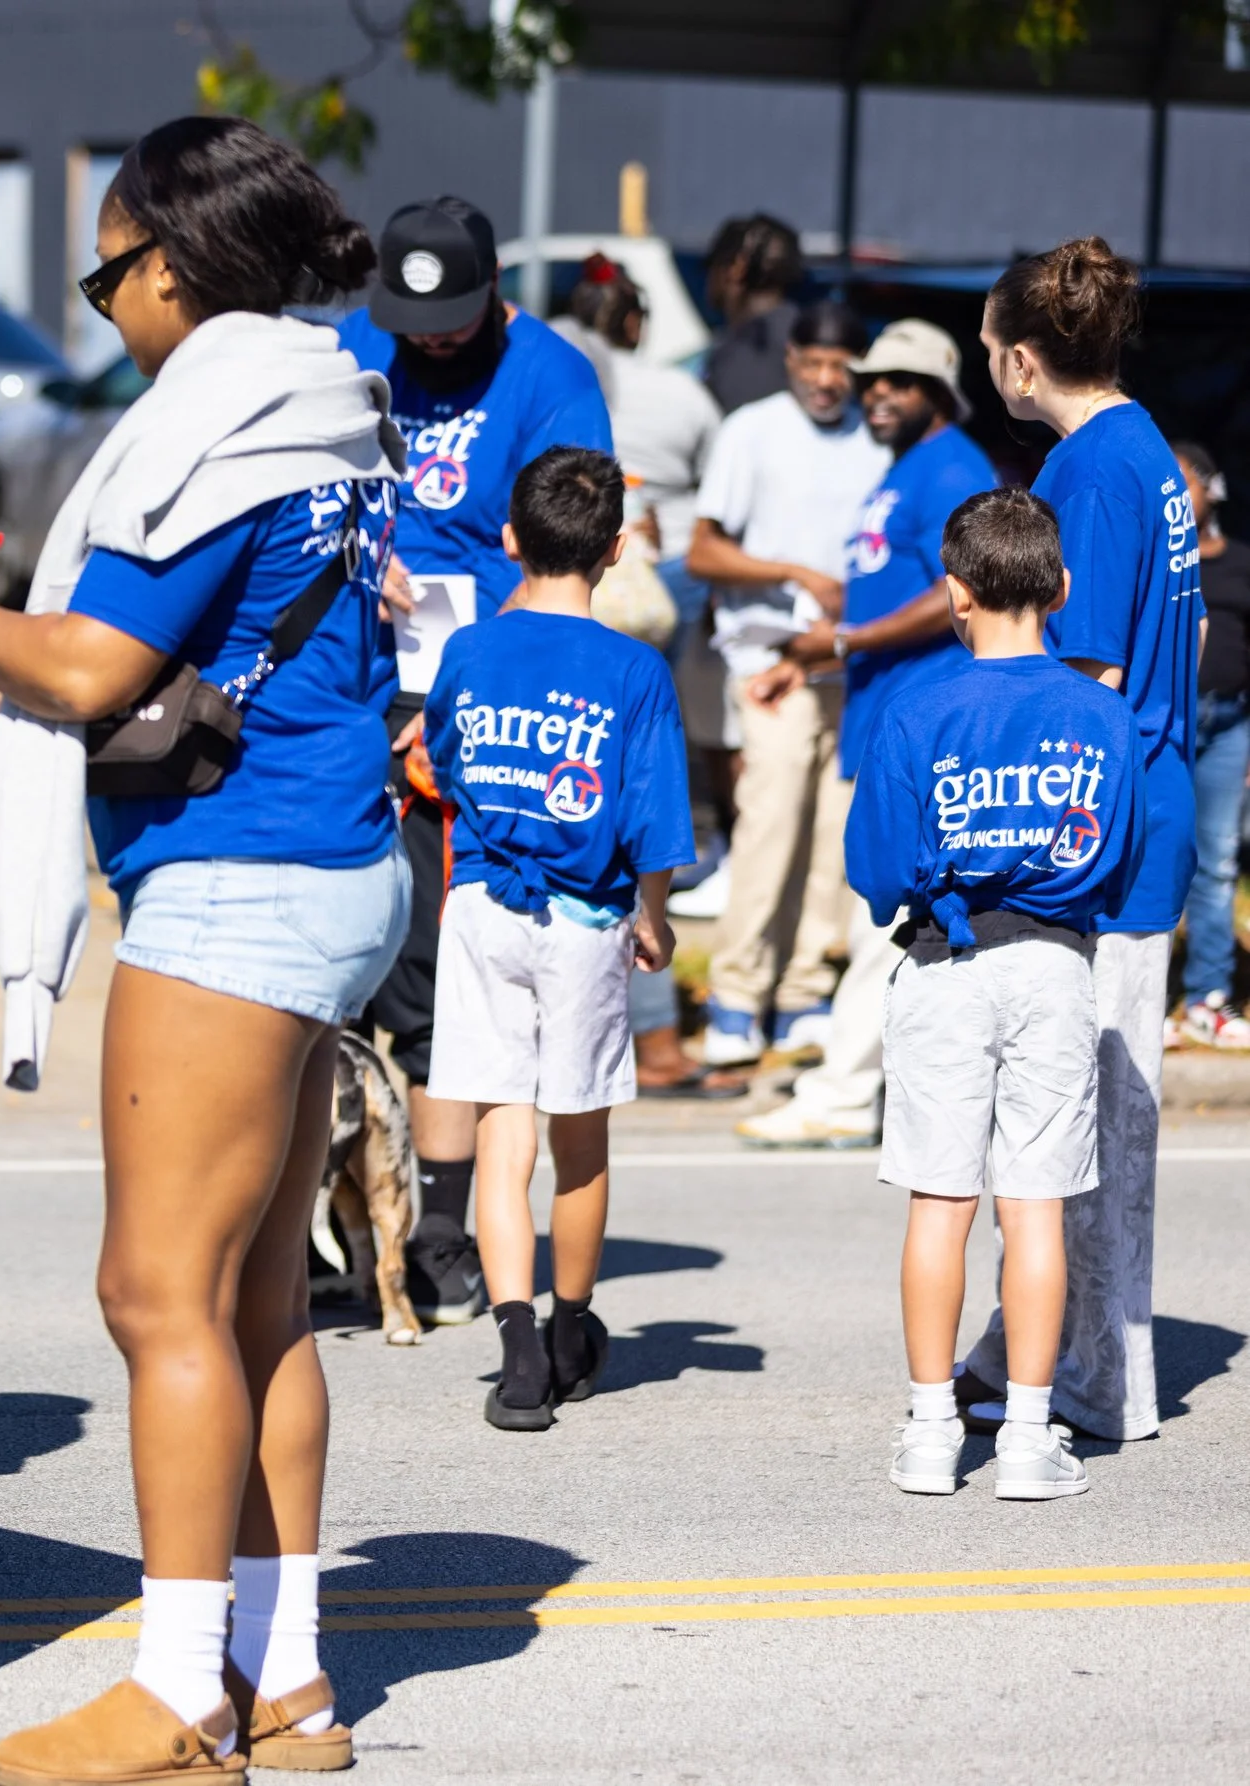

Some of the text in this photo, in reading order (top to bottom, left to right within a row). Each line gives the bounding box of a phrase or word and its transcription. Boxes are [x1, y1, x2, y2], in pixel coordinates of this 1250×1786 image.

[455, 705, 611, 768] garrett
[464, 765, 549, 792] OUNCILMAN
[932, 752, 961, 774] eric
[933, 756, 1104, 831] garrett
